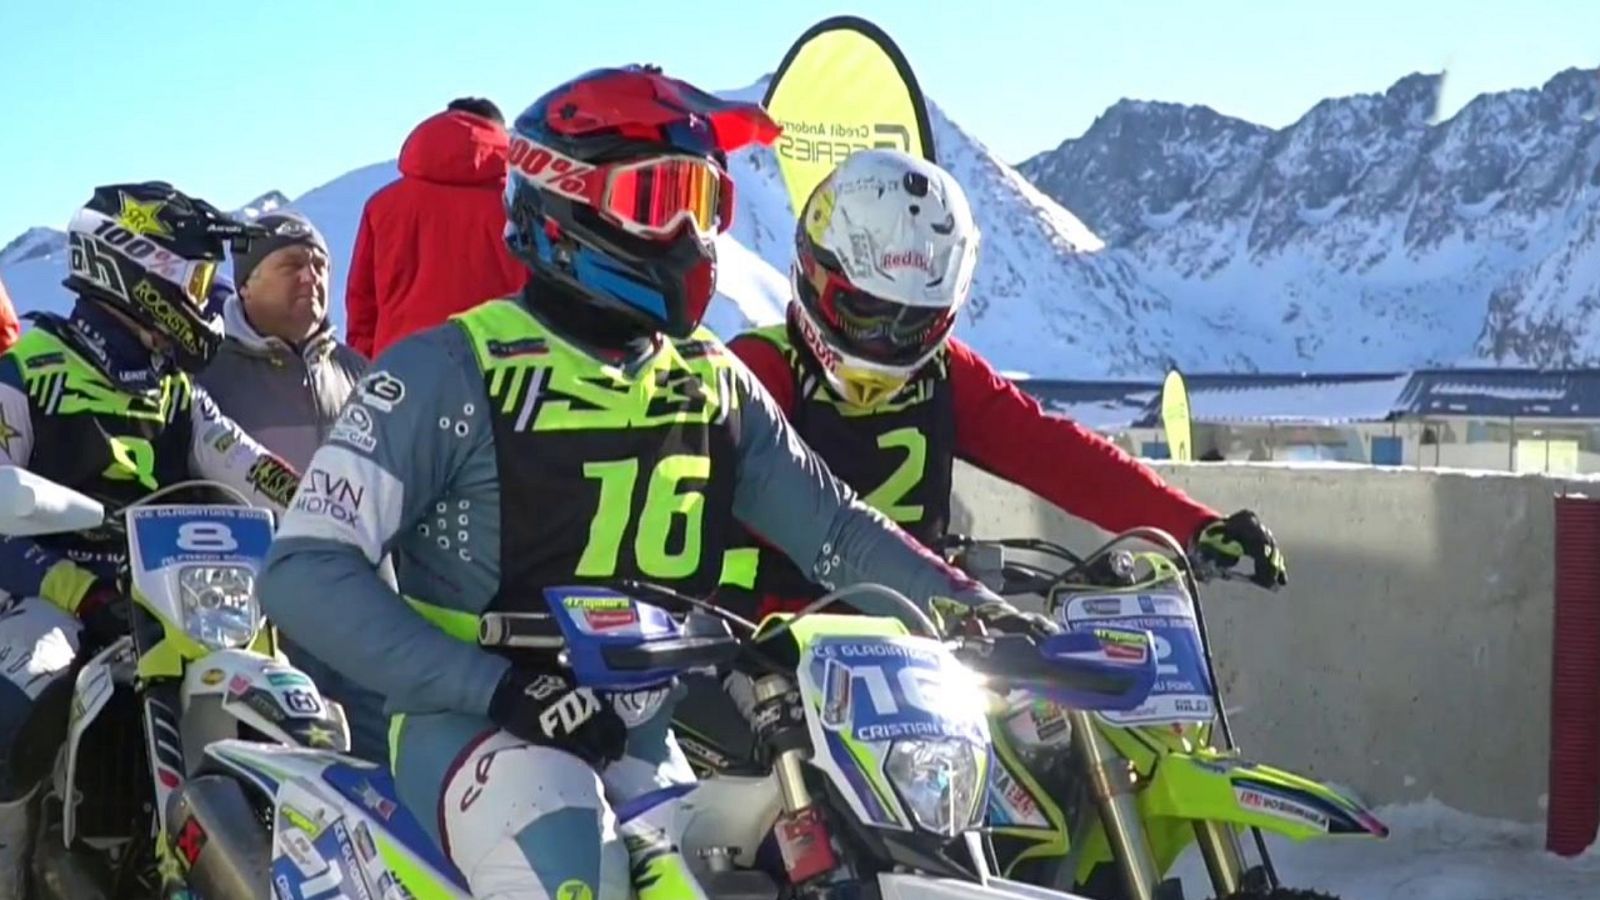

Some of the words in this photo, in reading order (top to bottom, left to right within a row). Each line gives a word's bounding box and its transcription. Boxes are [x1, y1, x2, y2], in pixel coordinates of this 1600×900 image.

[94, 219, 182, 278] 100%
[861, 426, 927, 523] 2
[176, 521, 239, 552] 8
[574, 454, 711, 579] 16
[813, 643, 838, 659] CE
[538, 686, 602, 739] FOX
[857, 721, 939, 741] CRISTIAN
